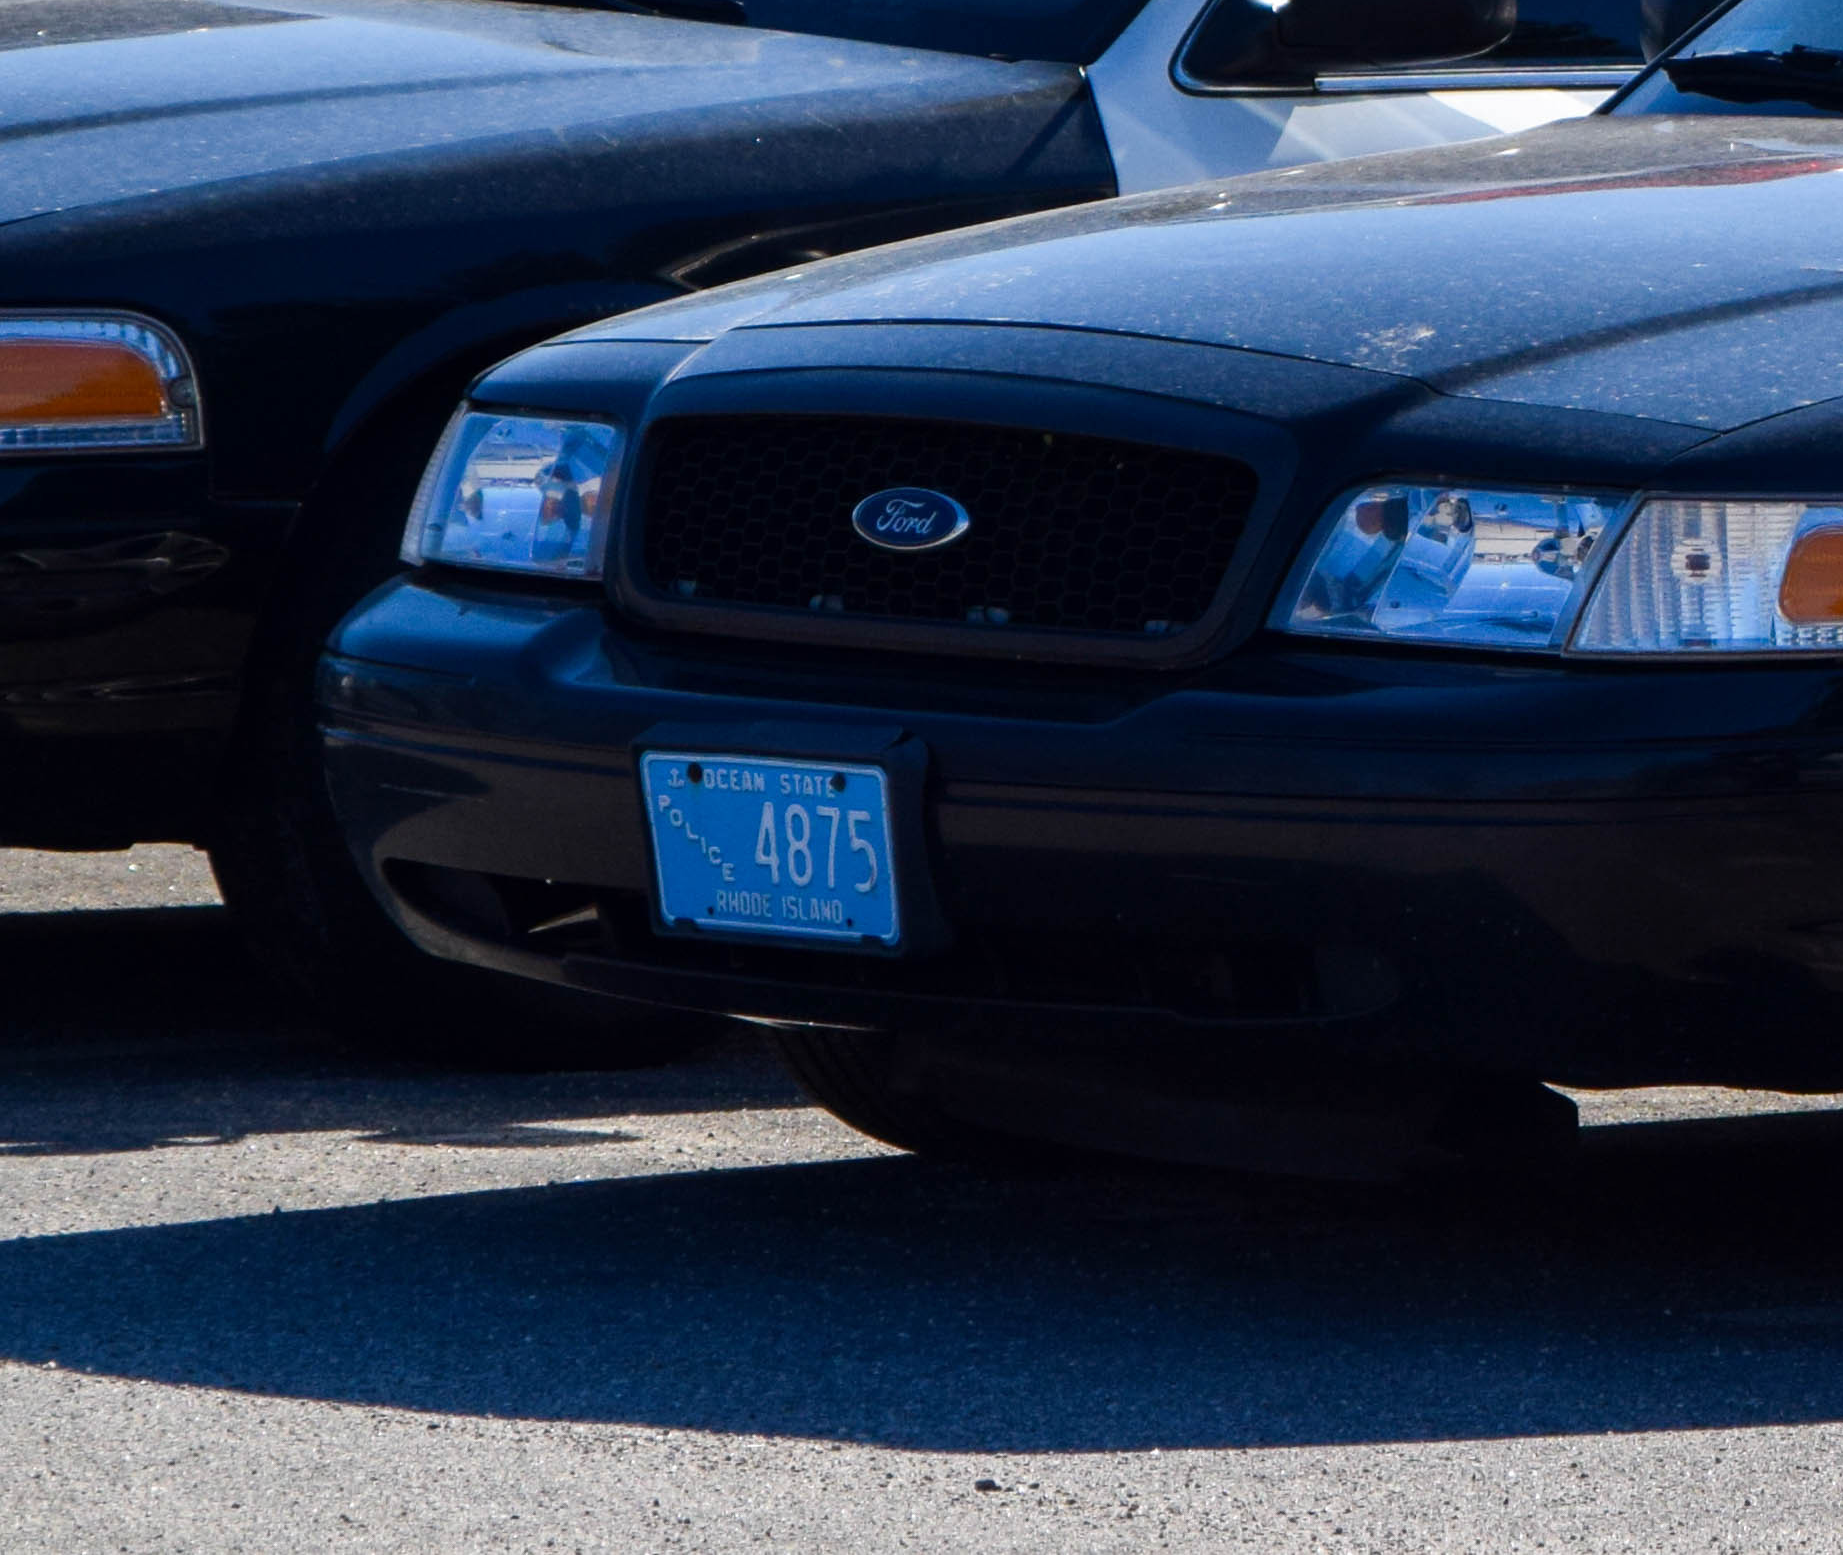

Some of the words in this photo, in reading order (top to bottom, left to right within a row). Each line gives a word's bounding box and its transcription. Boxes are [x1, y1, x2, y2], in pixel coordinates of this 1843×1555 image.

[876, 498, 938, 534] Ford
[703, 768, 766, 793] OCEAN
[780, 773, 836, 798] STATE
[658, 794, 736, 883] POLICE
[754, 801, 878, 893] 4875
[716, 890, 773, 918] RHODE
[782, 895, 843, 924] ISLAND
